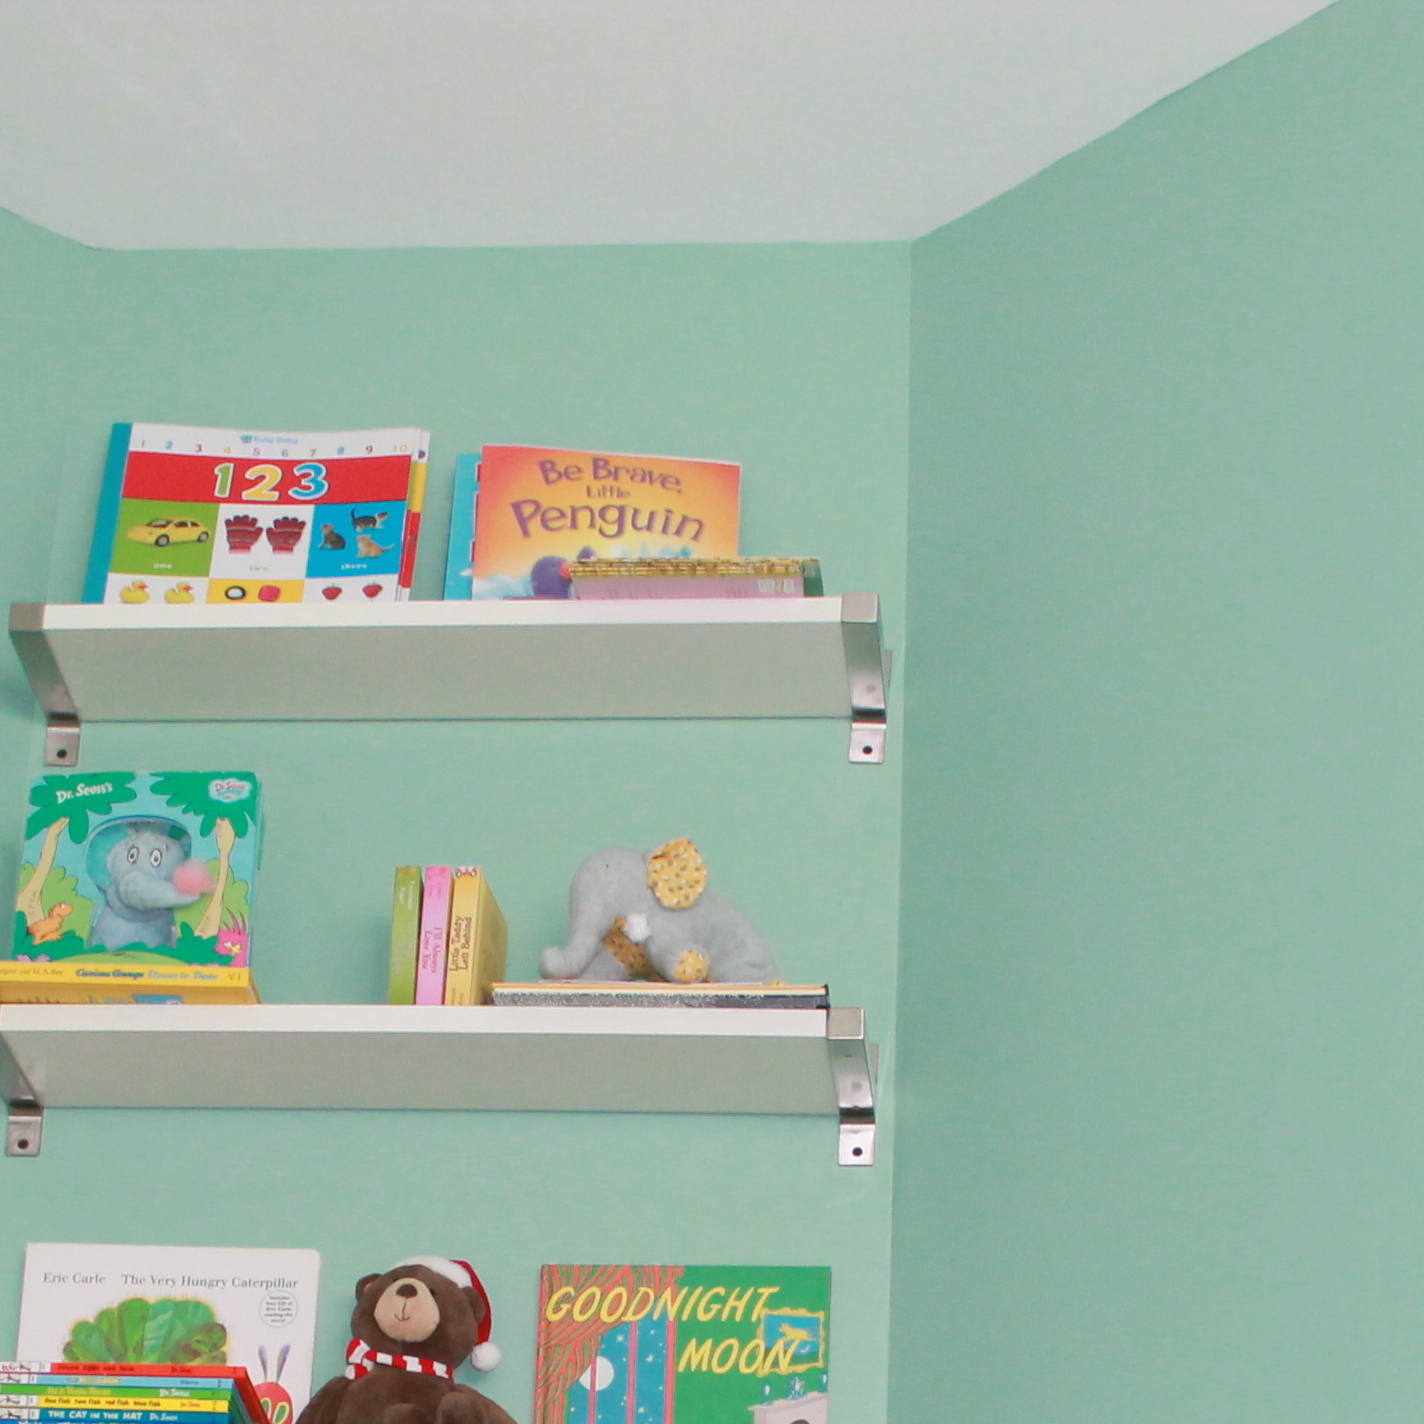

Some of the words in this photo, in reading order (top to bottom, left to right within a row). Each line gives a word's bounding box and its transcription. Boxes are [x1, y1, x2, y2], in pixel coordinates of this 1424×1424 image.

[165, 440, 173, 449] 2
[194, 443, 203, 453] 3
[253, 448, 261, 456] 5
[281, 449, 289, 457] 6
[309, 449, 317, 457] 7
[337, 446, 344, 455] 8
[365, 445, 373, 454] 9
[393, 444, 408, 453] 10
[538, 459, 583, 486] Be
[586, 485, 631, 499] Little
[511, 499, 706, 542] Penguin
[56, 790, 74, 804] Dr.
[76, 782, 113, 797] Seuss's
[450, 915, 463, 945] Teddy
[461, 916, 472, 949] Behind
[448, 947, 460, 972] Little
[459, 952, 469, 971] Left
[43, 1272, 69, 1285] Eric
[72, 1272, 106, 1286] Carle
[121, 1274, 147, 1286] The
[150, 1274, 176, 1289] Very
[181, 1275, 228, 1290] Hungry
[231, 1275, 299, 1291] Caterpillar
[545, 1286, 780, 1323] GOODNIGHT
[678, 1338, 800, 1374] MOON
[169, 1388, 190, 1397] Seuss
[48, 1410, 65, 1418] THE
[68, 1411, 87, 1419] CAT
[123, 1412, 143, 1420] HAT
